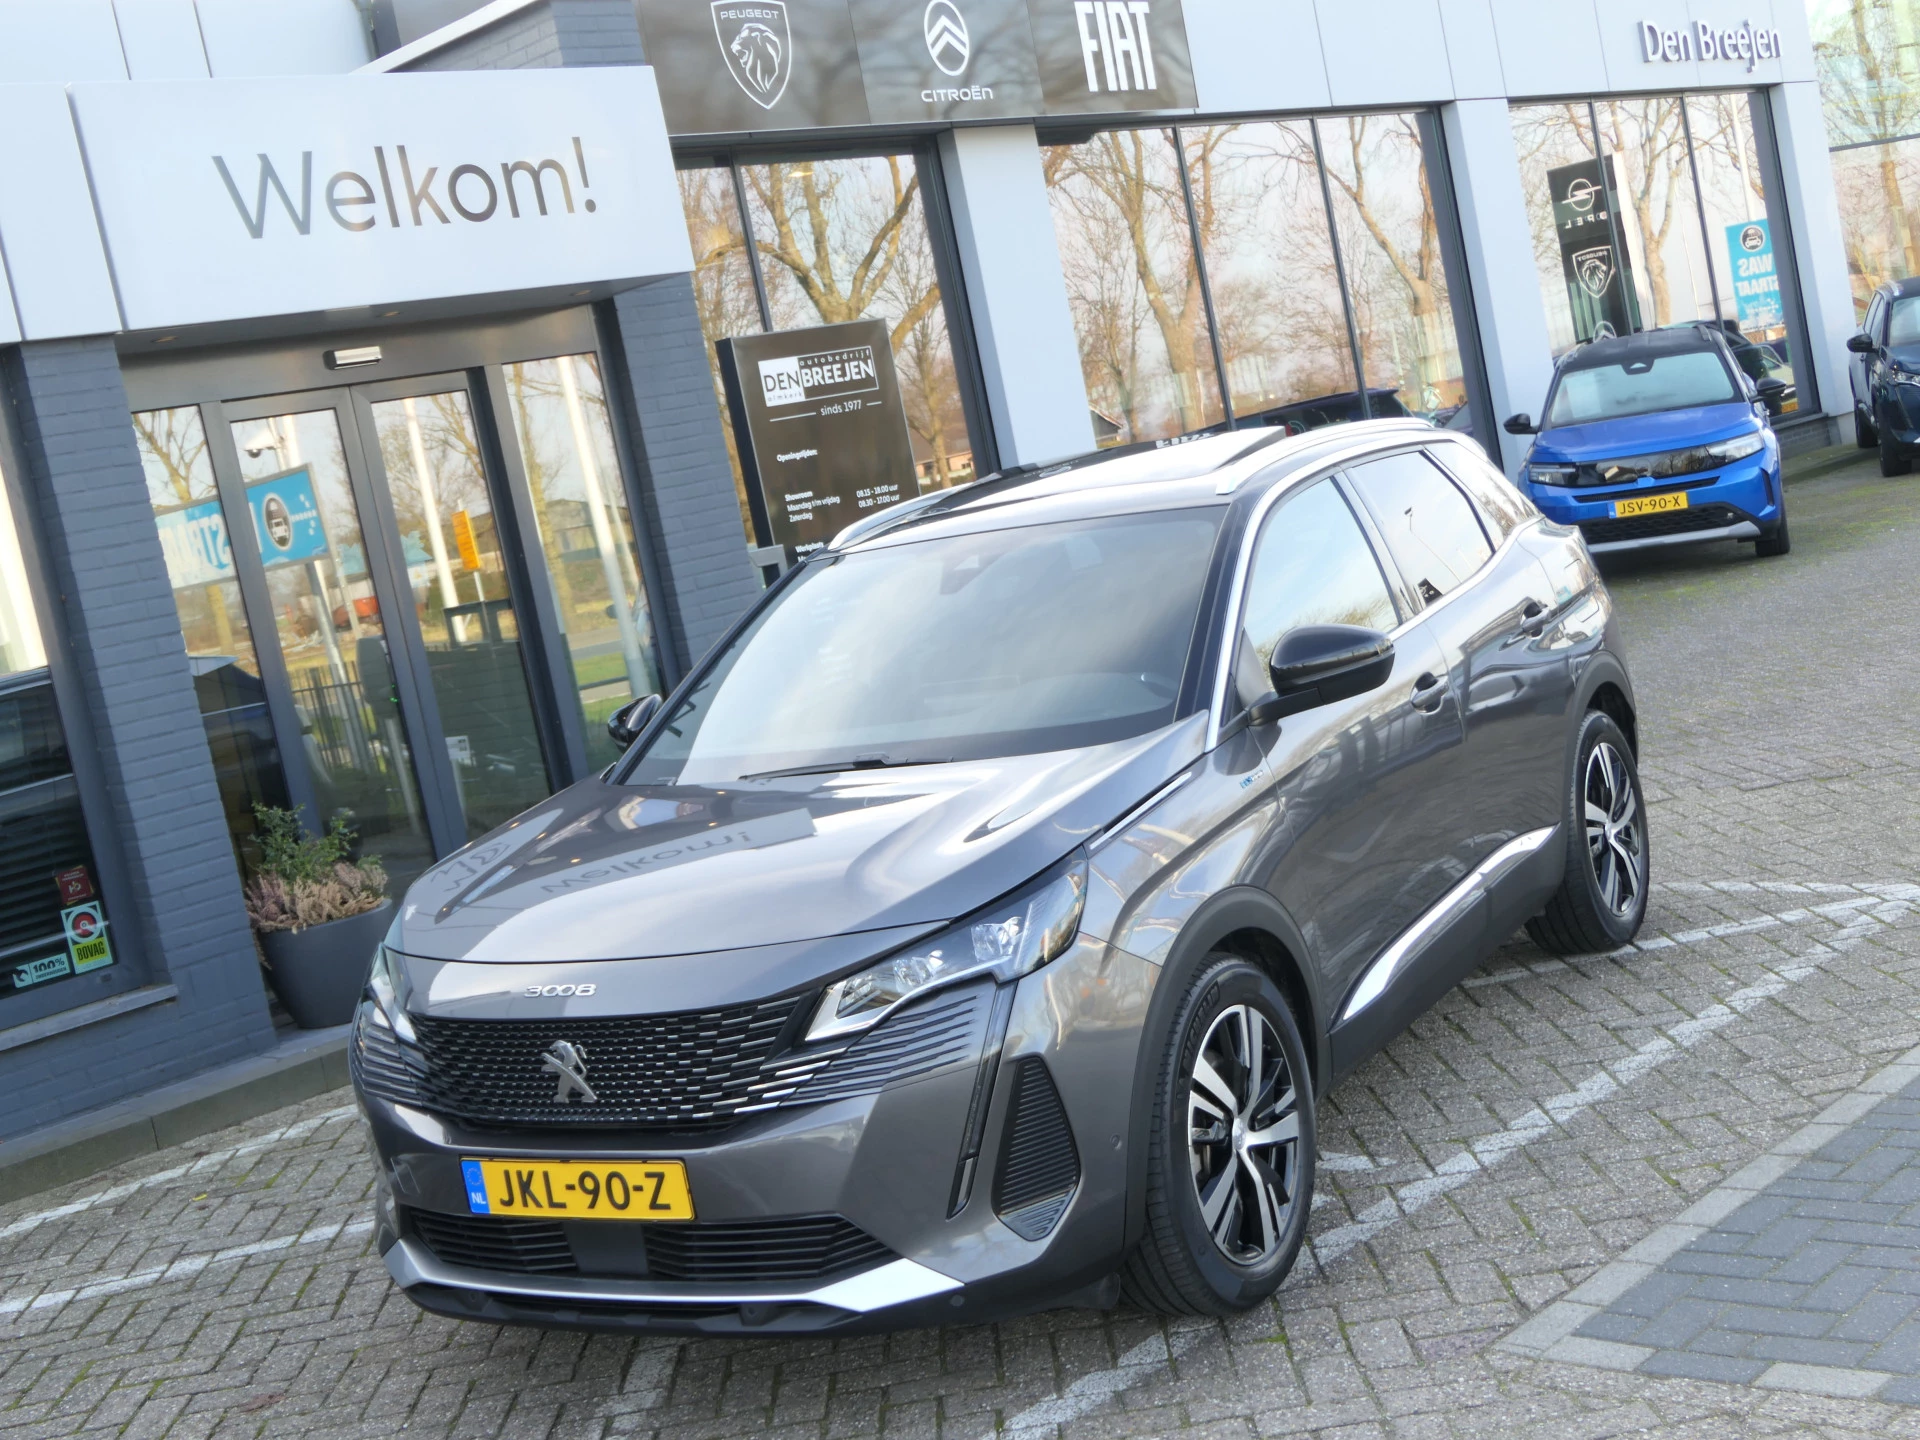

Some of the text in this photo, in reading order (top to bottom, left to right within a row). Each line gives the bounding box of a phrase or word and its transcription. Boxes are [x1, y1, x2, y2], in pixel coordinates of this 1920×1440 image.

[720, 9, 779, 20] PEUGEOT
[1074, 1, 1157, 92] FIAT
[1637, 18, 1783, 73] Den Breejen
[211, 137, 597, 239] Welkom!
[800, 349, 870, 366] autobedrijf
[763, 359, 875, 392] DEN BREEJEN
[820, 400, 862, 416] sinds 1977
[1620, 495, 1681, 515] JSV-90-X
[76, 941, 105, 961] BOVAG
[524, 984, 597, 998] 3008
[471, 1169, 671, 1211] NL JKL-90-Z
